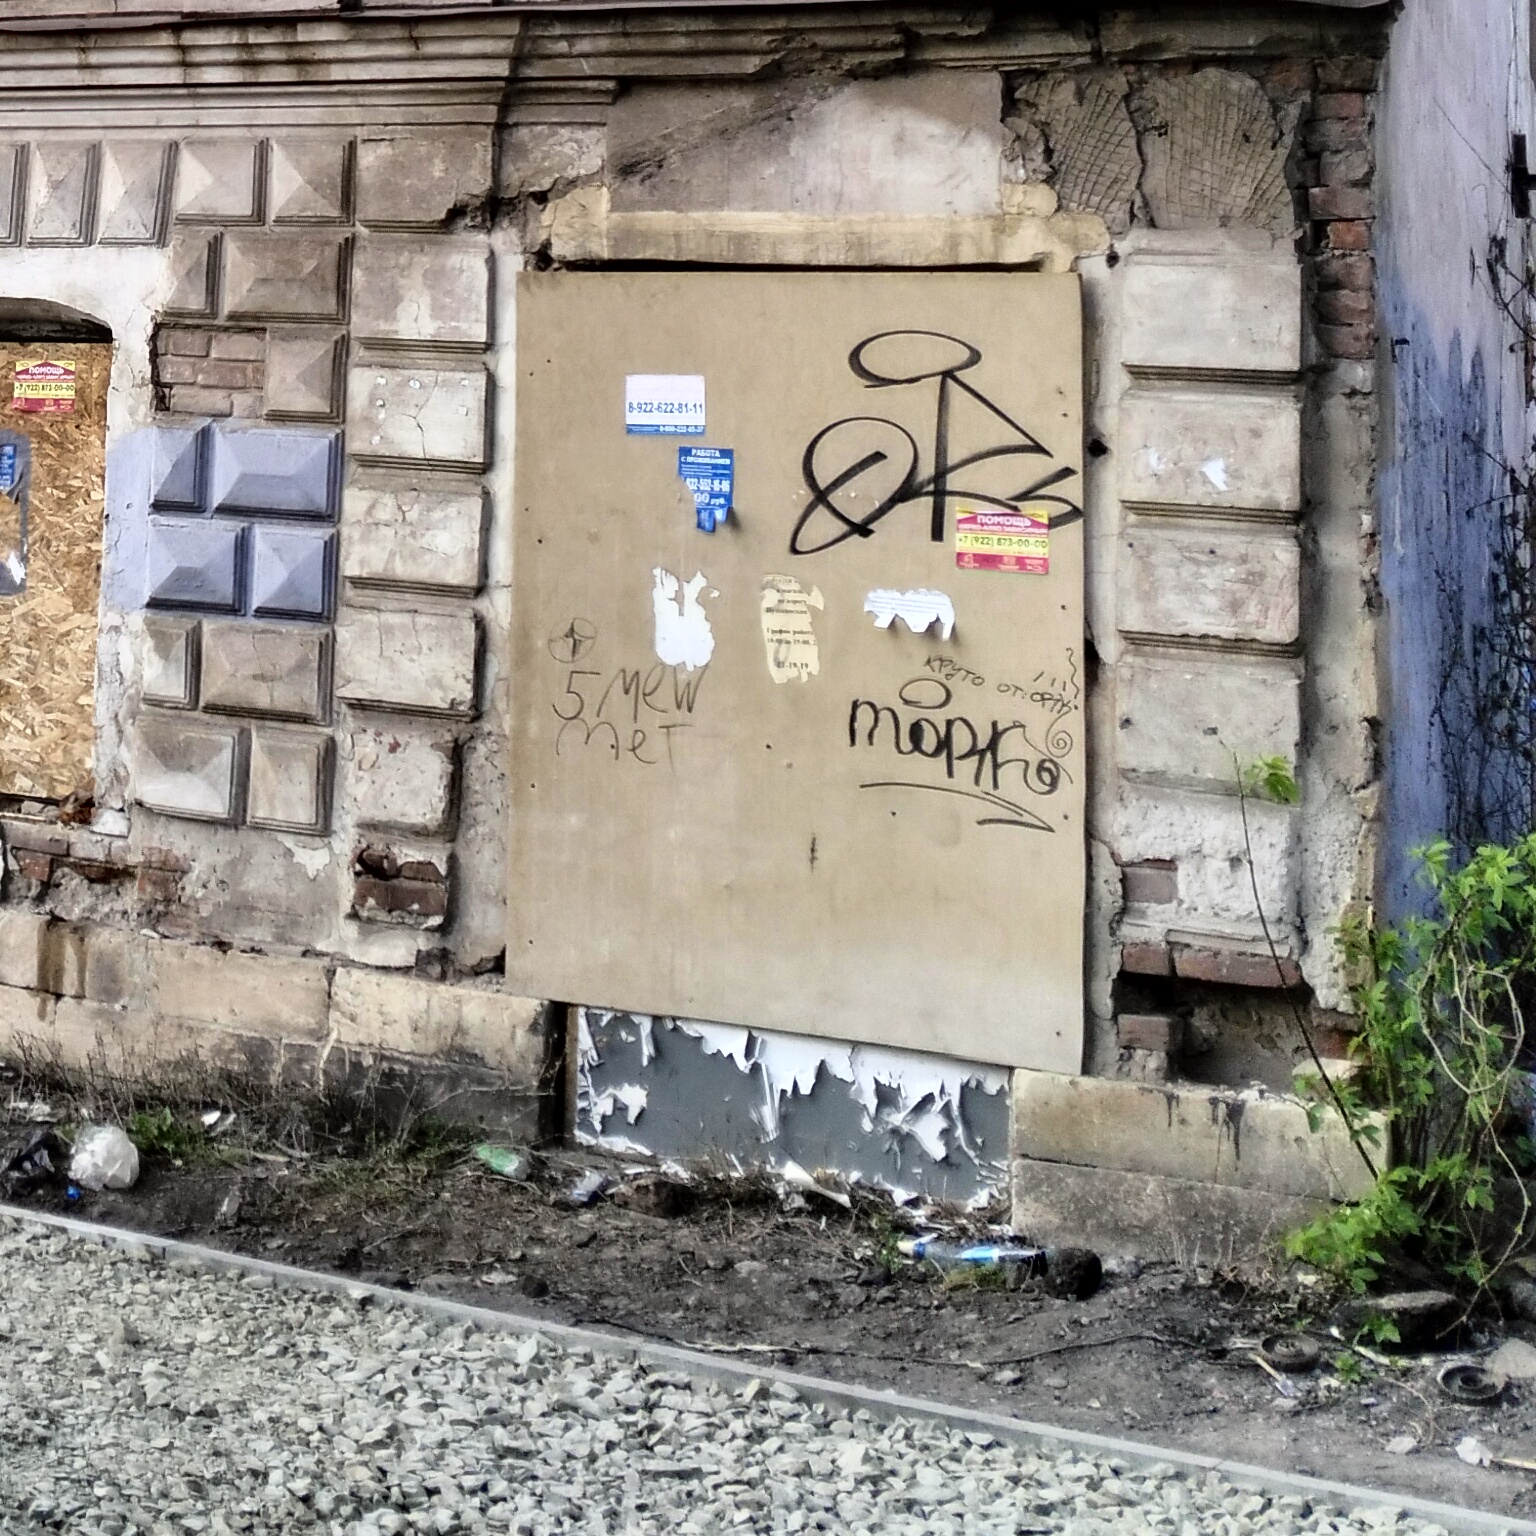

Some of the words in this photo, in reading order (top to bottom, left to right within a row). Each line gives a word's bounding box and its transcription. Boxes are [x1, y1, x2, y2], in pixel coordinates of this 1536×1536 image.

[628, 401, 704, 414] 8-922-622-81-11
[691, 448, 721, 457] РАБОТА
[976, 514, 1032, 527] ПОМОЩЬ
